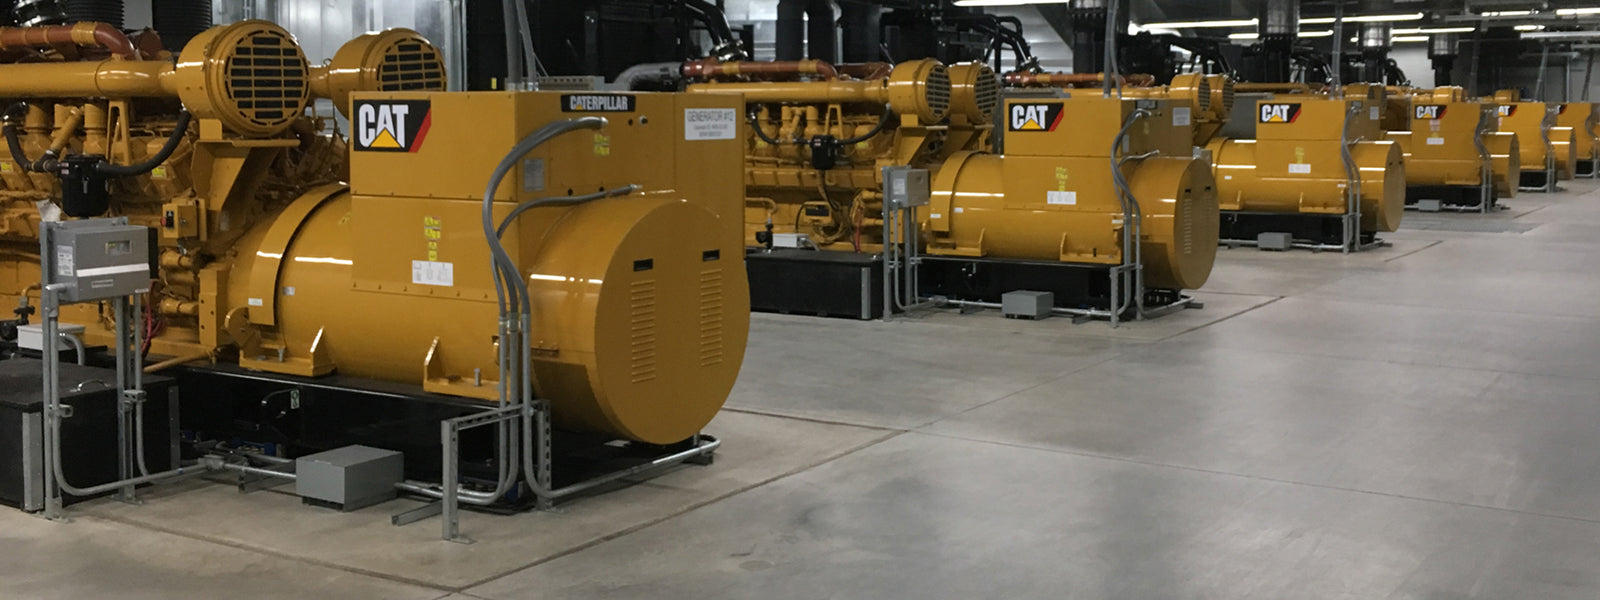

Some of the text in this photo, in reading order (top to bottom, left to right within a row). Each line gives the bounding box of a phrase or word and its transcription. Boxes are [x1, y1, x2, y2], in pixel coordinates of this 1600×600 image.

[569, 95, 629, 111] CATERPILLAR
[687, 110, 722, 122] GENERATOR
[1012, 105, 1048, 130] CAT
[1261, 104, 1290, 122] CAT
[1416, 106, 1438, 119] CAT
[358, 103, 409, 148] CAT
